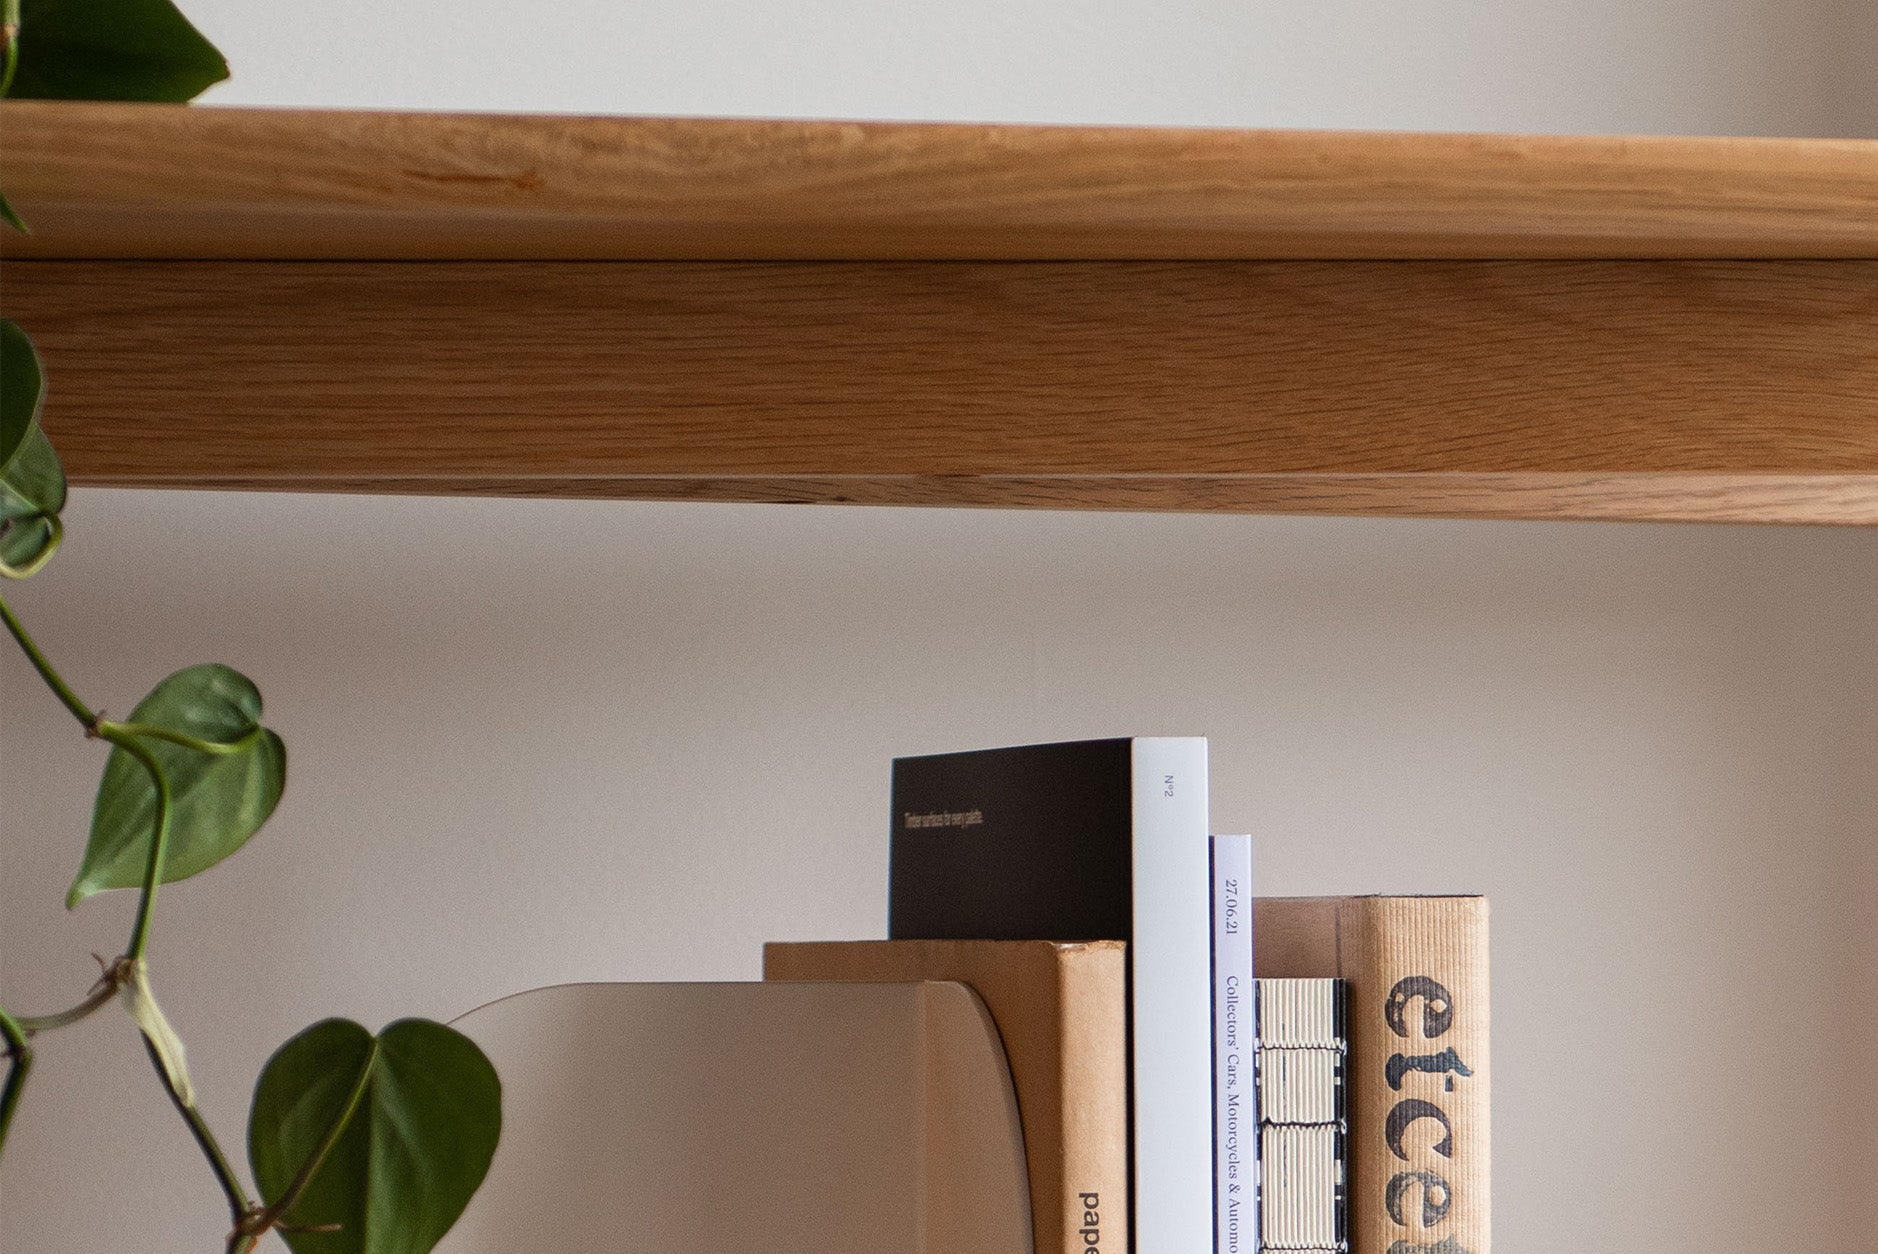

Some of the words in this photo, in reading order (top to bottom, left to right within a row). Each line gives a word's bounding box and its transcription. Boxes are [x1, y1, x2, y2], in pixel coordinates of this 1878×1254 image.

[1225, 879, 1239, 935] 27.06.21
[1226, 1053, 1240, 1090] Cars,
[1225, 1093, 1241, 1180] Motorcycles
[1228, 1183, 1241, 1194] &
